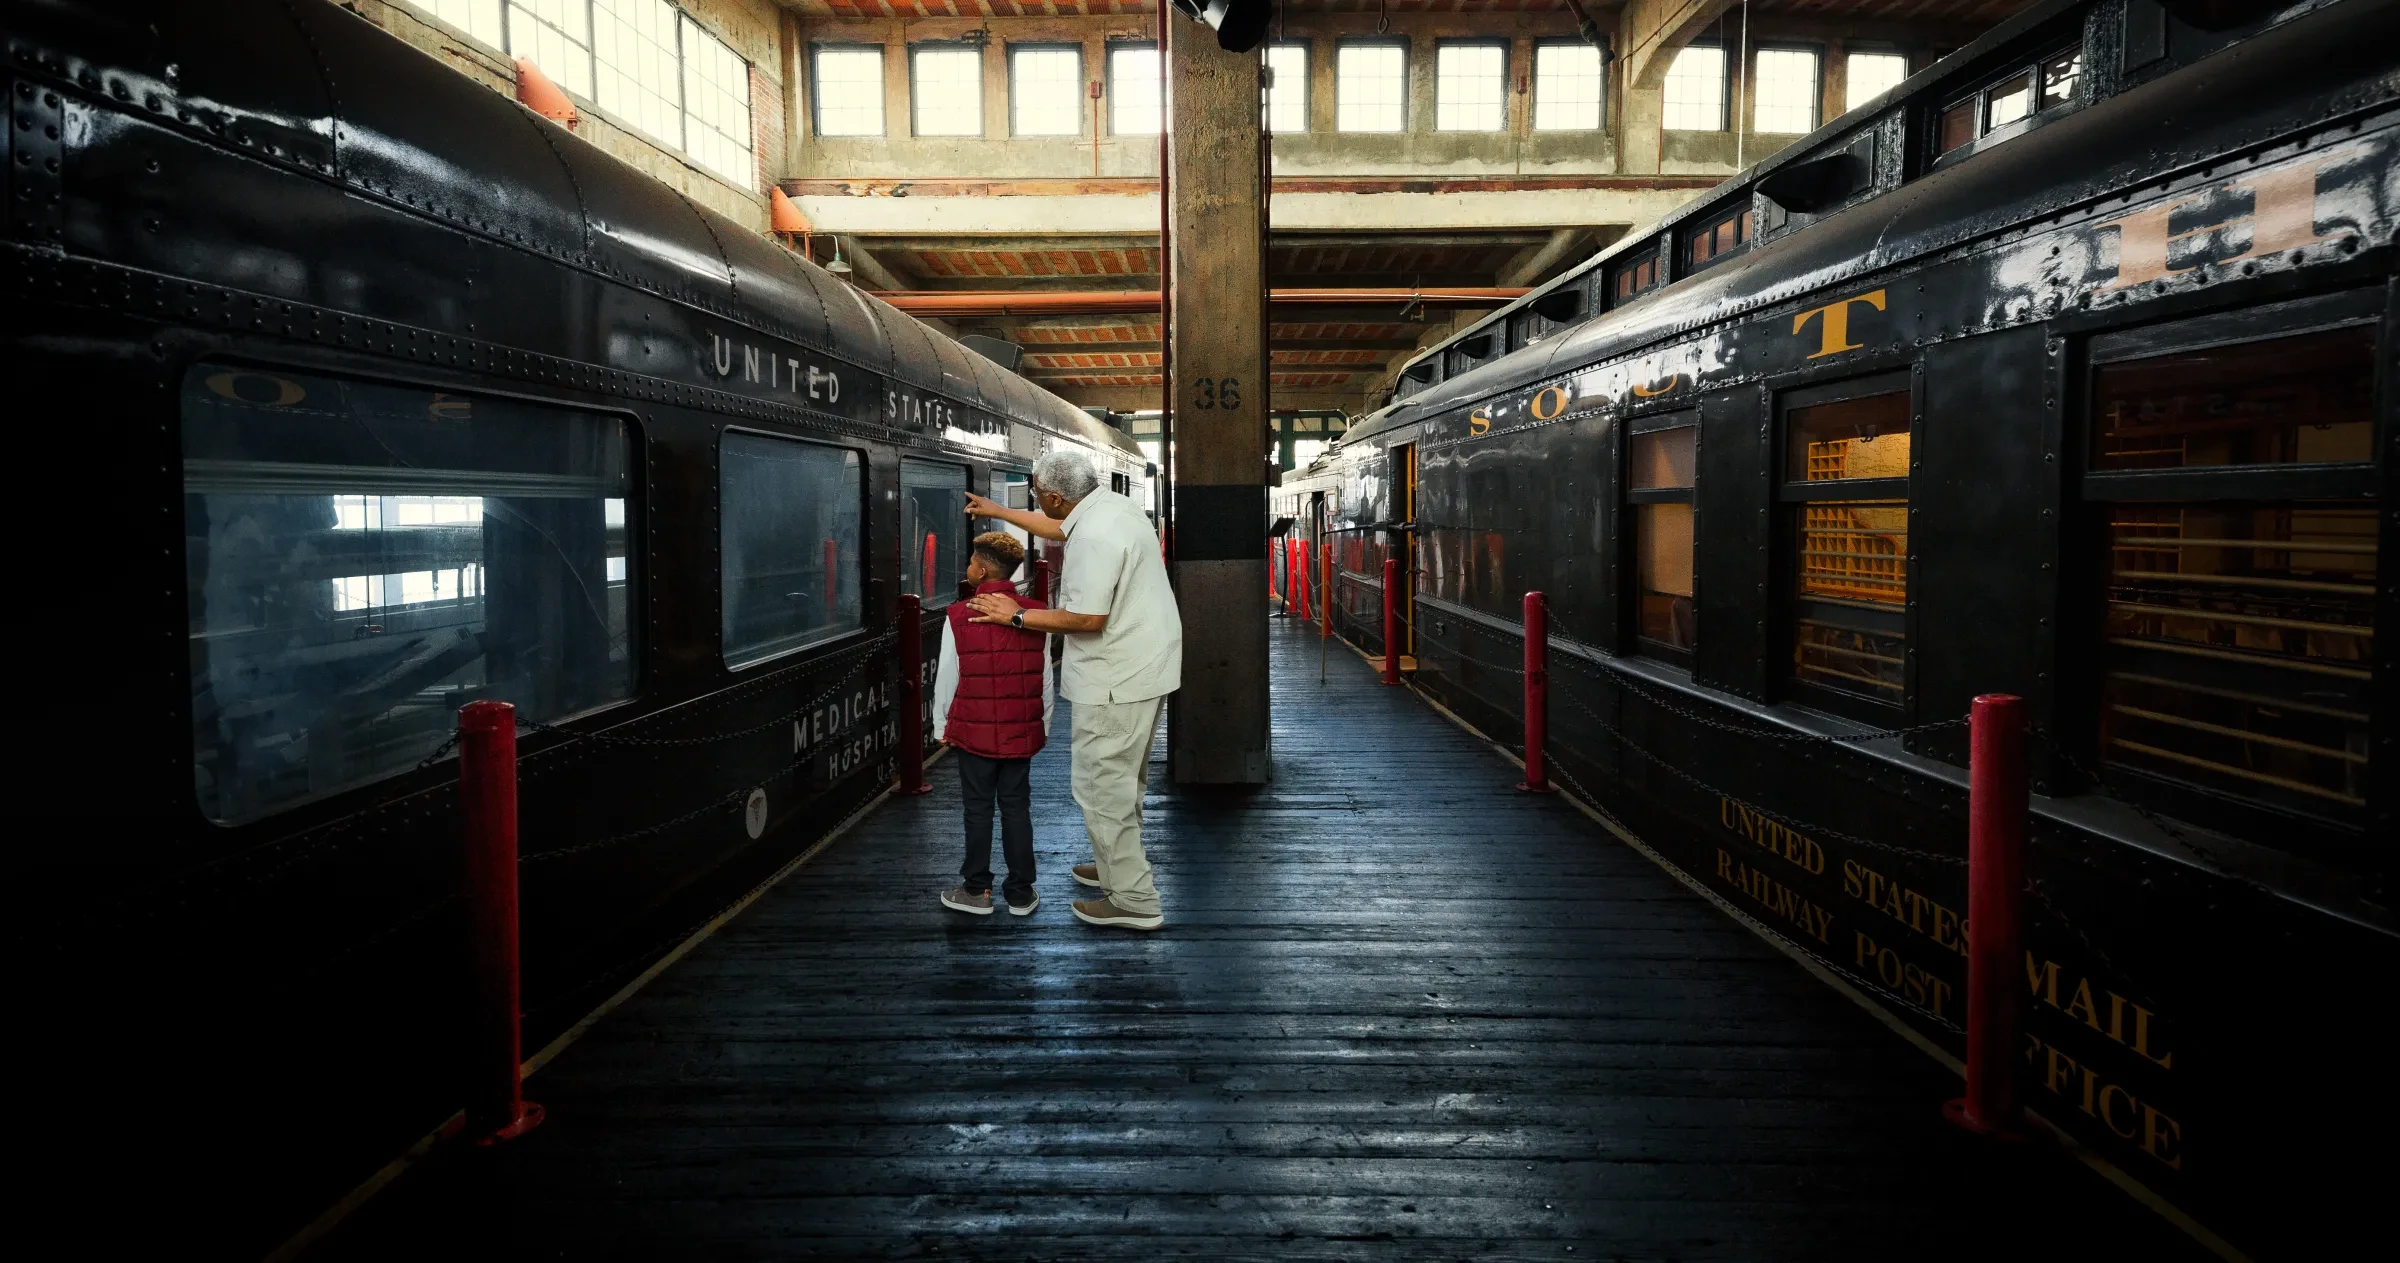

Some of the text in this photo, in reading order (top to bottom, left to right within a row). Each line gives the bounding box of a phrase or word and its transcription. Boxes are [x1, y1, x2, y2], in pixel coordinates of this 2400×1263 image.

[713, 334, 840, 404] UNITED
[888, 390, 953, 430] STATES
[1194, 377, 1241, 411] 36
[794, 681, 890, 754] MEDICAL
[829, 720, 897, 781] HOSPITA
[1720, 796, 1825, 876] UNITED
[2025, 949, 2176, 1071] MAIL
[1717, 847, 2183, 1172] RAILWAY POST FICE
